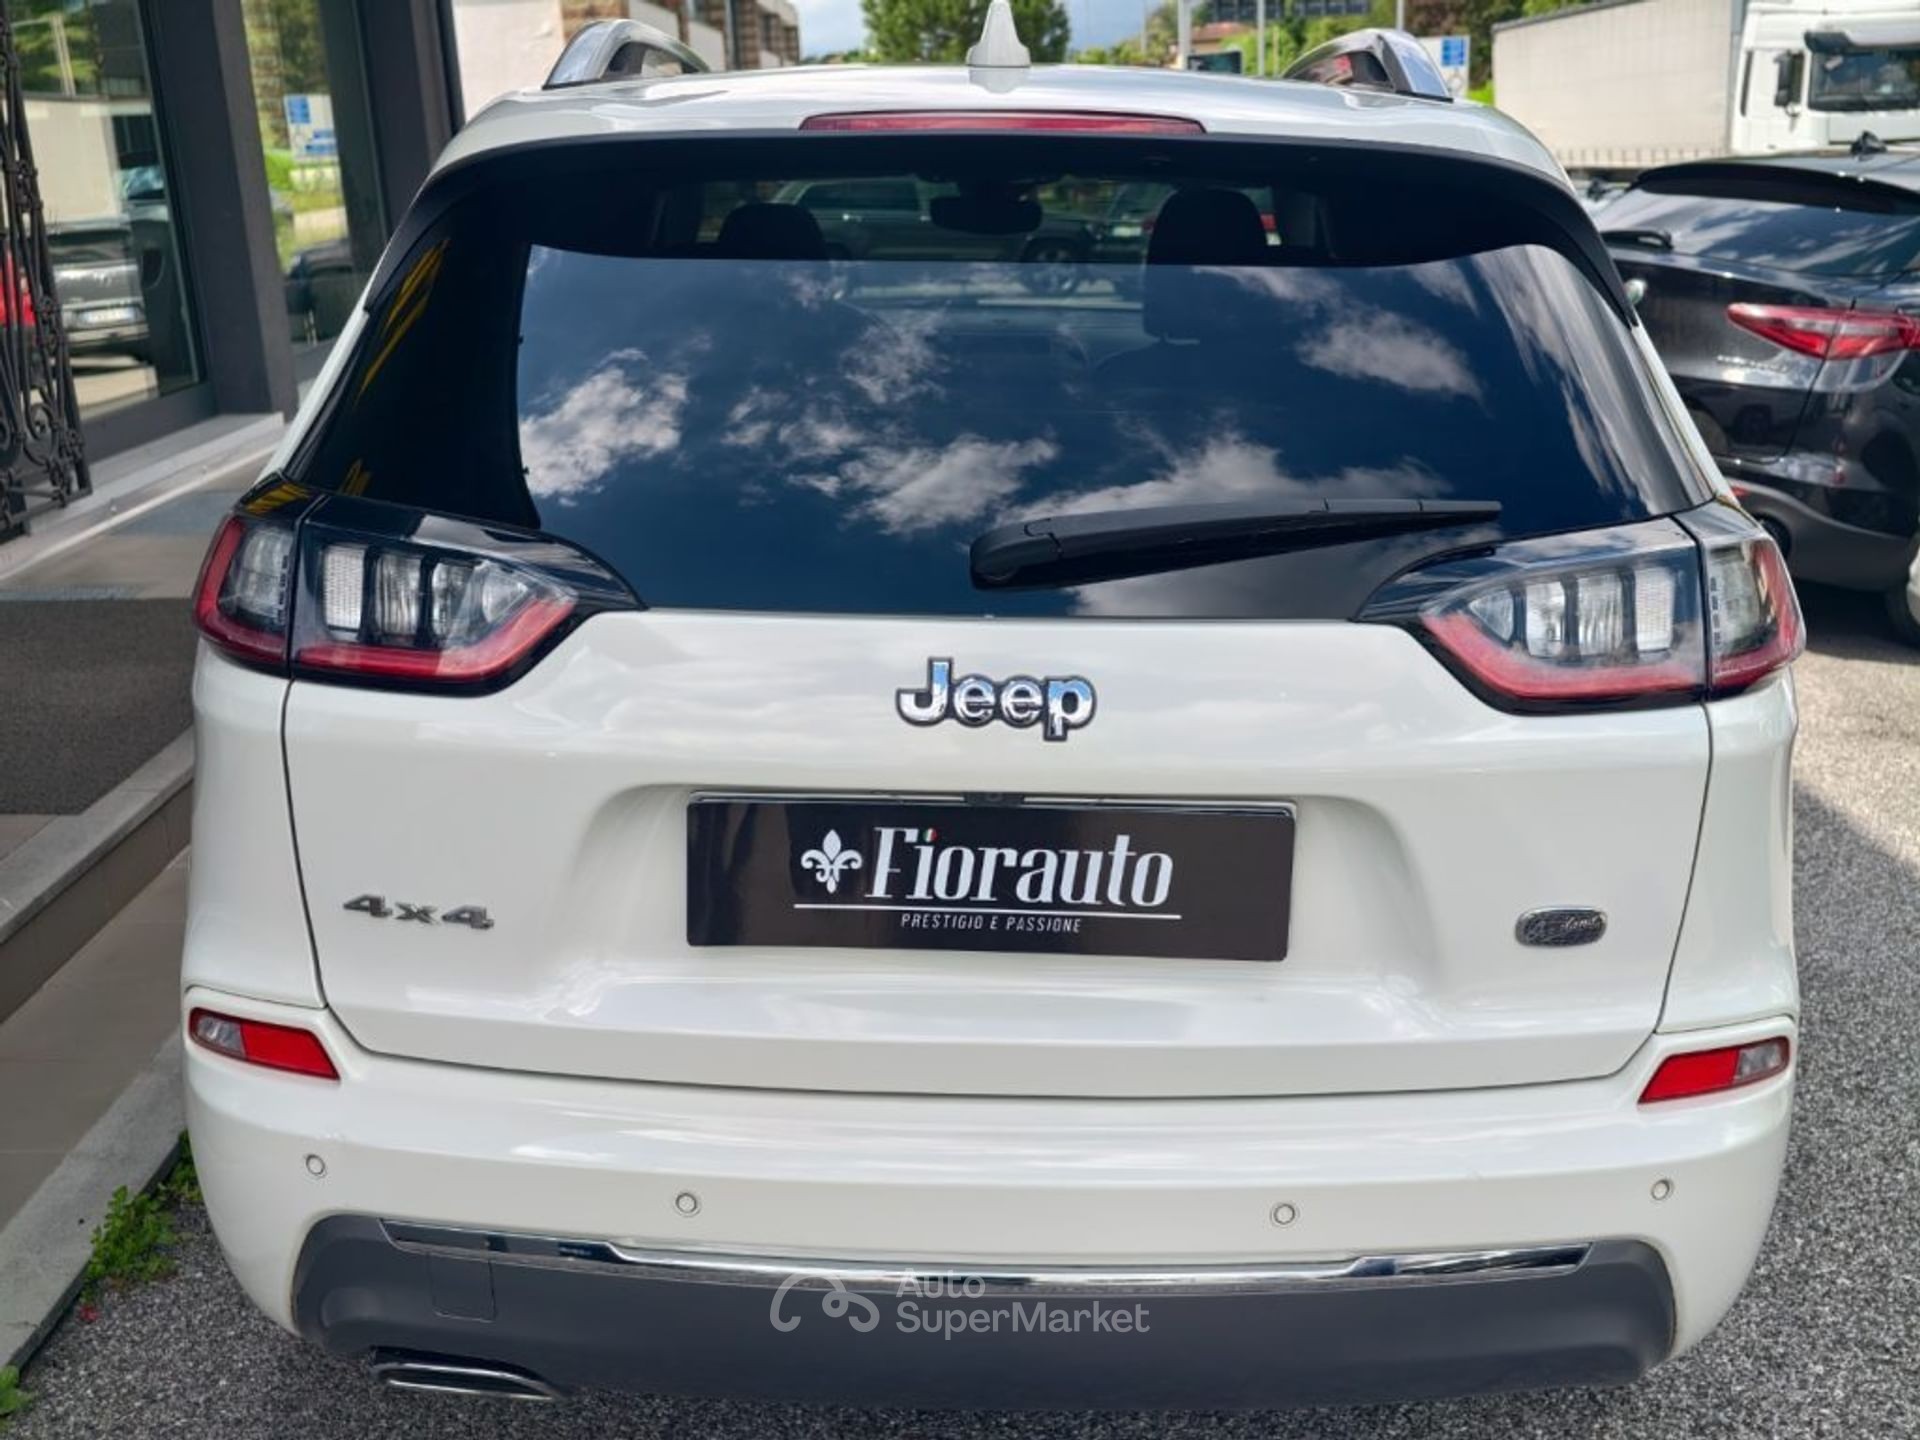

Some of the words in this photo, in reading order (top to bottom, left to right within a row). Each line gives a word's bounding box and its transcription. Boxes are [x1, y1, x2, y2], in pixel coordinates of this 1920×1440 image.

[896, 657, 1097, 742] Jeep
[864, 826, 1174, 907] Fiorauto
[901, 912, 984, 930] PRESTIGIO
[990, 915, 999, 930] E
[1006, 916, 1082, 933] PASSIONE
